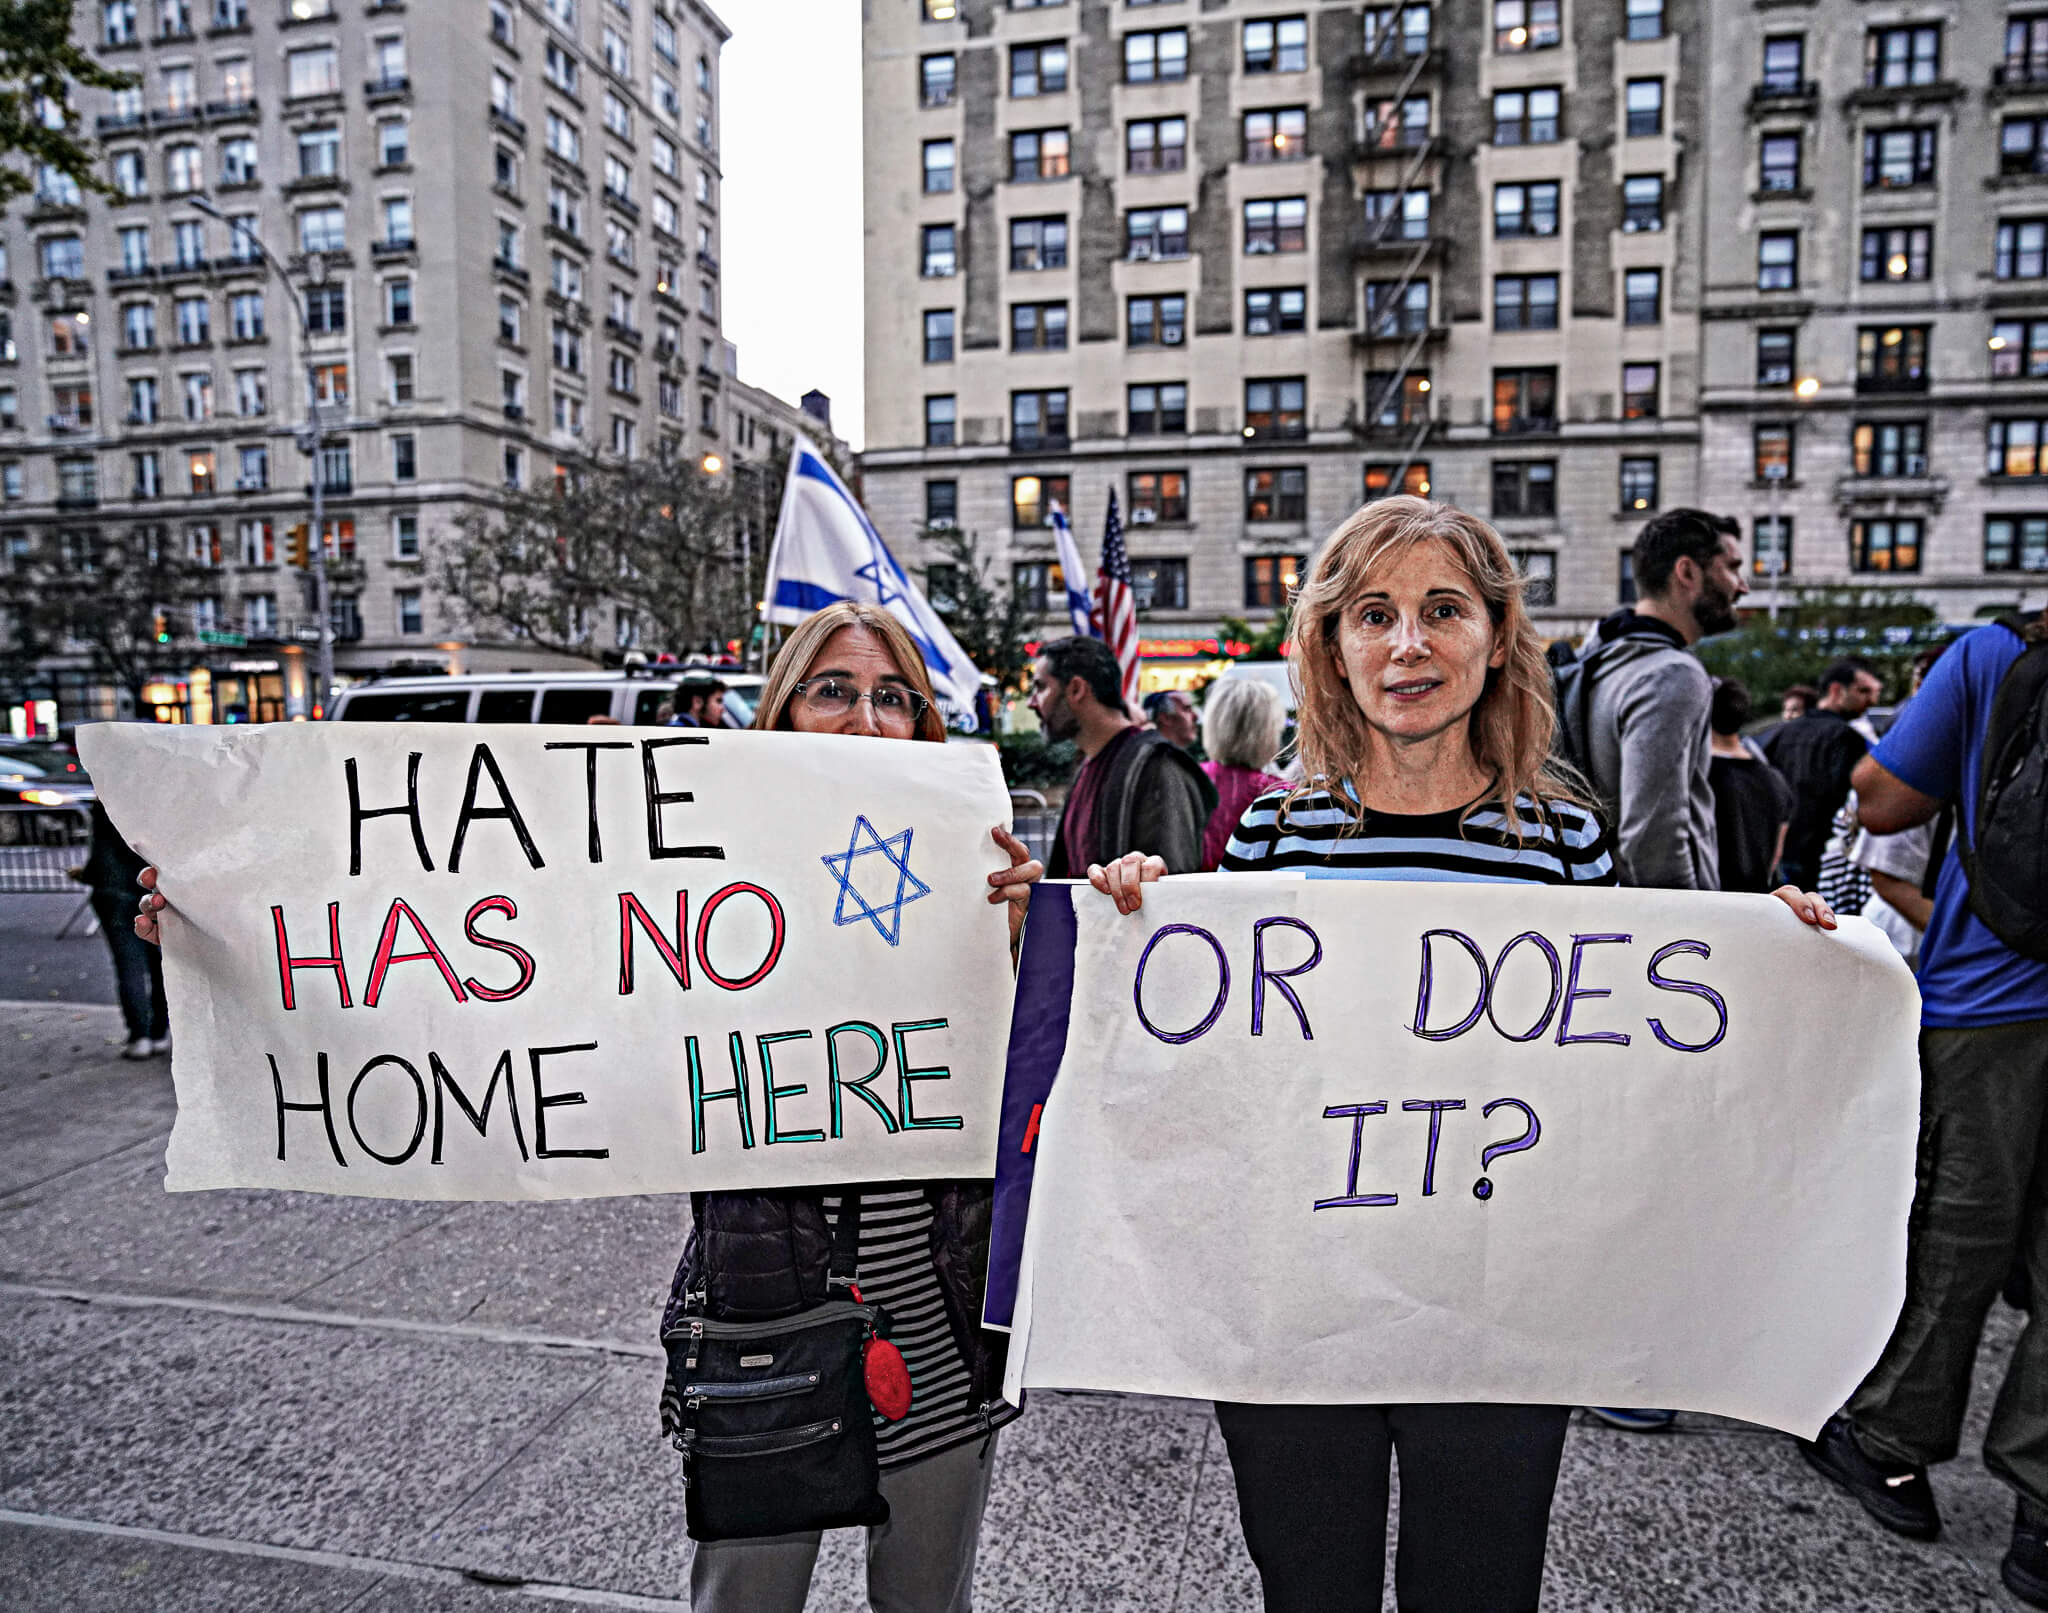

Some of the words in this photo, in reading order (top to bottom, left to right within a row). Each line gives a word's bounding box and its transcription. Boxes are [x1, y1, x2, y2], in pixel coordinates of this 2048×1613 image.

[344, 736, 726, 876] HATE
[271, 895, 536, 1010] HAS
[617, 881, 786, 996] NO
[1134, 917, 1323, 1045] OR
[1405, 930, 1728, 1053] DOES
[266, 1041, 609, 1167] HOME
[686, 1018, 963, 1155] HERE
[1313, 1097, 1542, 1212] IT?
